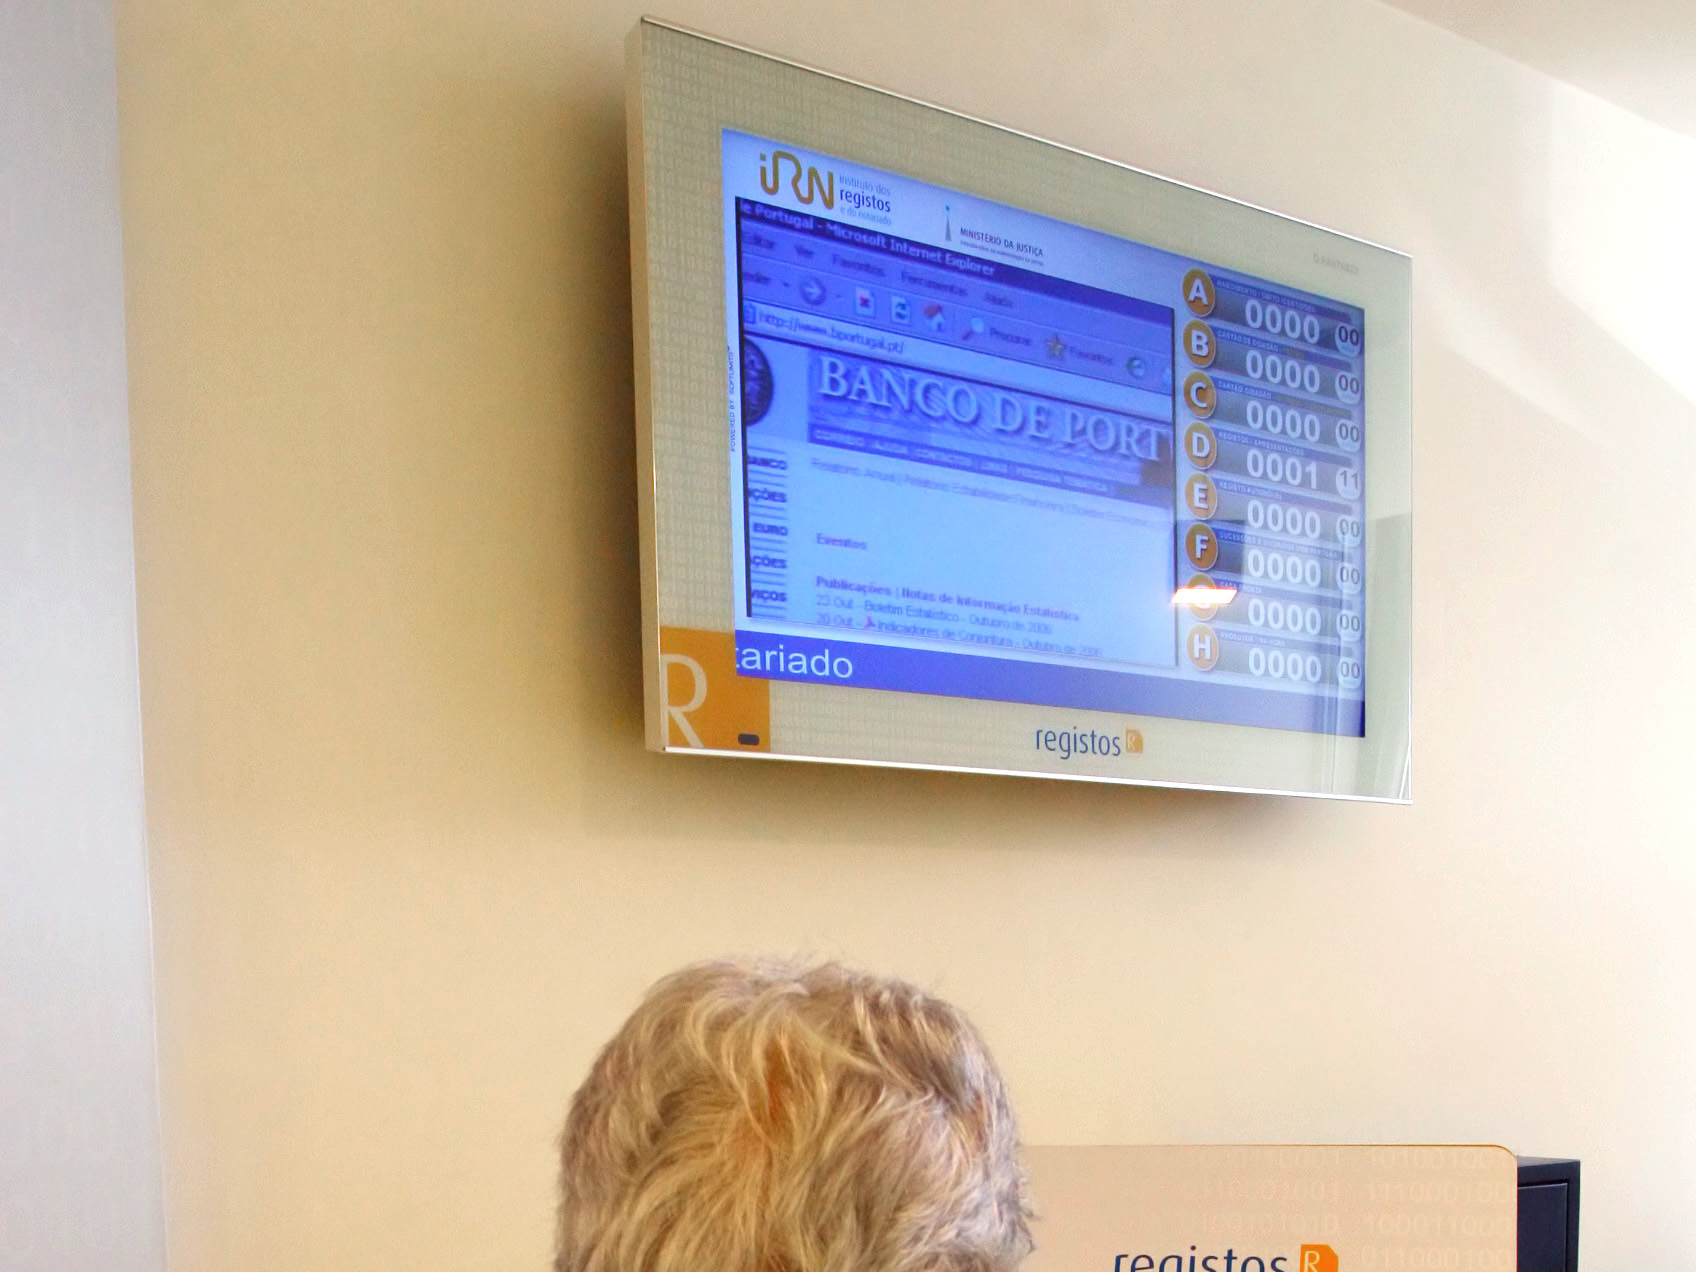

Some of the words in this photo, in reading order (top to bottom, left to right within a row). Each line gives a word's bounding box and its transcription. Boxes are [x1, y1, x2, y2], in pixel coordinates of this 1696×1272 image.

[840, 188, 891, 213] registos
[755, 203, 814, 230] Portugal
[827, 222, 887, 248] Microsoft
[890, 239, 942, 264] Internet
[945, 254, 996, 277] Explorer
[960, 227, 1002, 246] MINISTÉRIO
[1003, 239, 1014, 249] DA
[1016, 243, 1044, 257] JUSTIÇA
[1188, 278, 1209, 306] A
[1245, 299, 1320, 344] 0000
[1338, 325, 1360, 346] 00
[1190, 330, 1209, 357] B
[1246, 350, 1320, 393] 0000
[1338, 374, 1360, 394] 00
[818, 356, 980, 424] BANCO
[993, 394, 1051, 440] DE
[1062, 411, 1171, 461] PORT
[1190, 382, 1208, 408] C
[1247, 400, 1321, 442] 0000
[1338, 422, 1360, 443] 00
[1191, 432, 1210, 458] D
[1247, 448, 1318, 489] 0001
[1340, 470, 1359, 489] 11
[1193, 482, 1209, 509] E
[1247, 500, 1321, 539] 0000
[1339, 517, 1361, 538] 00
[1195, 534, 1209, 559] F
[1247, 549, 1321, 587] 0000
[1339, 566, 1360, 585] 00
[1248, 598, 1322, 635] 0000
[1339, 613, 1360, 632] 00
[735, 644, 853, 678] ariado
[1193, 633, 1212, 660] H
[1248, 647, 1322, 683] 0000
[1339, 661, 1360, 679] 00
[1036, 726, 1121, 760] registos
